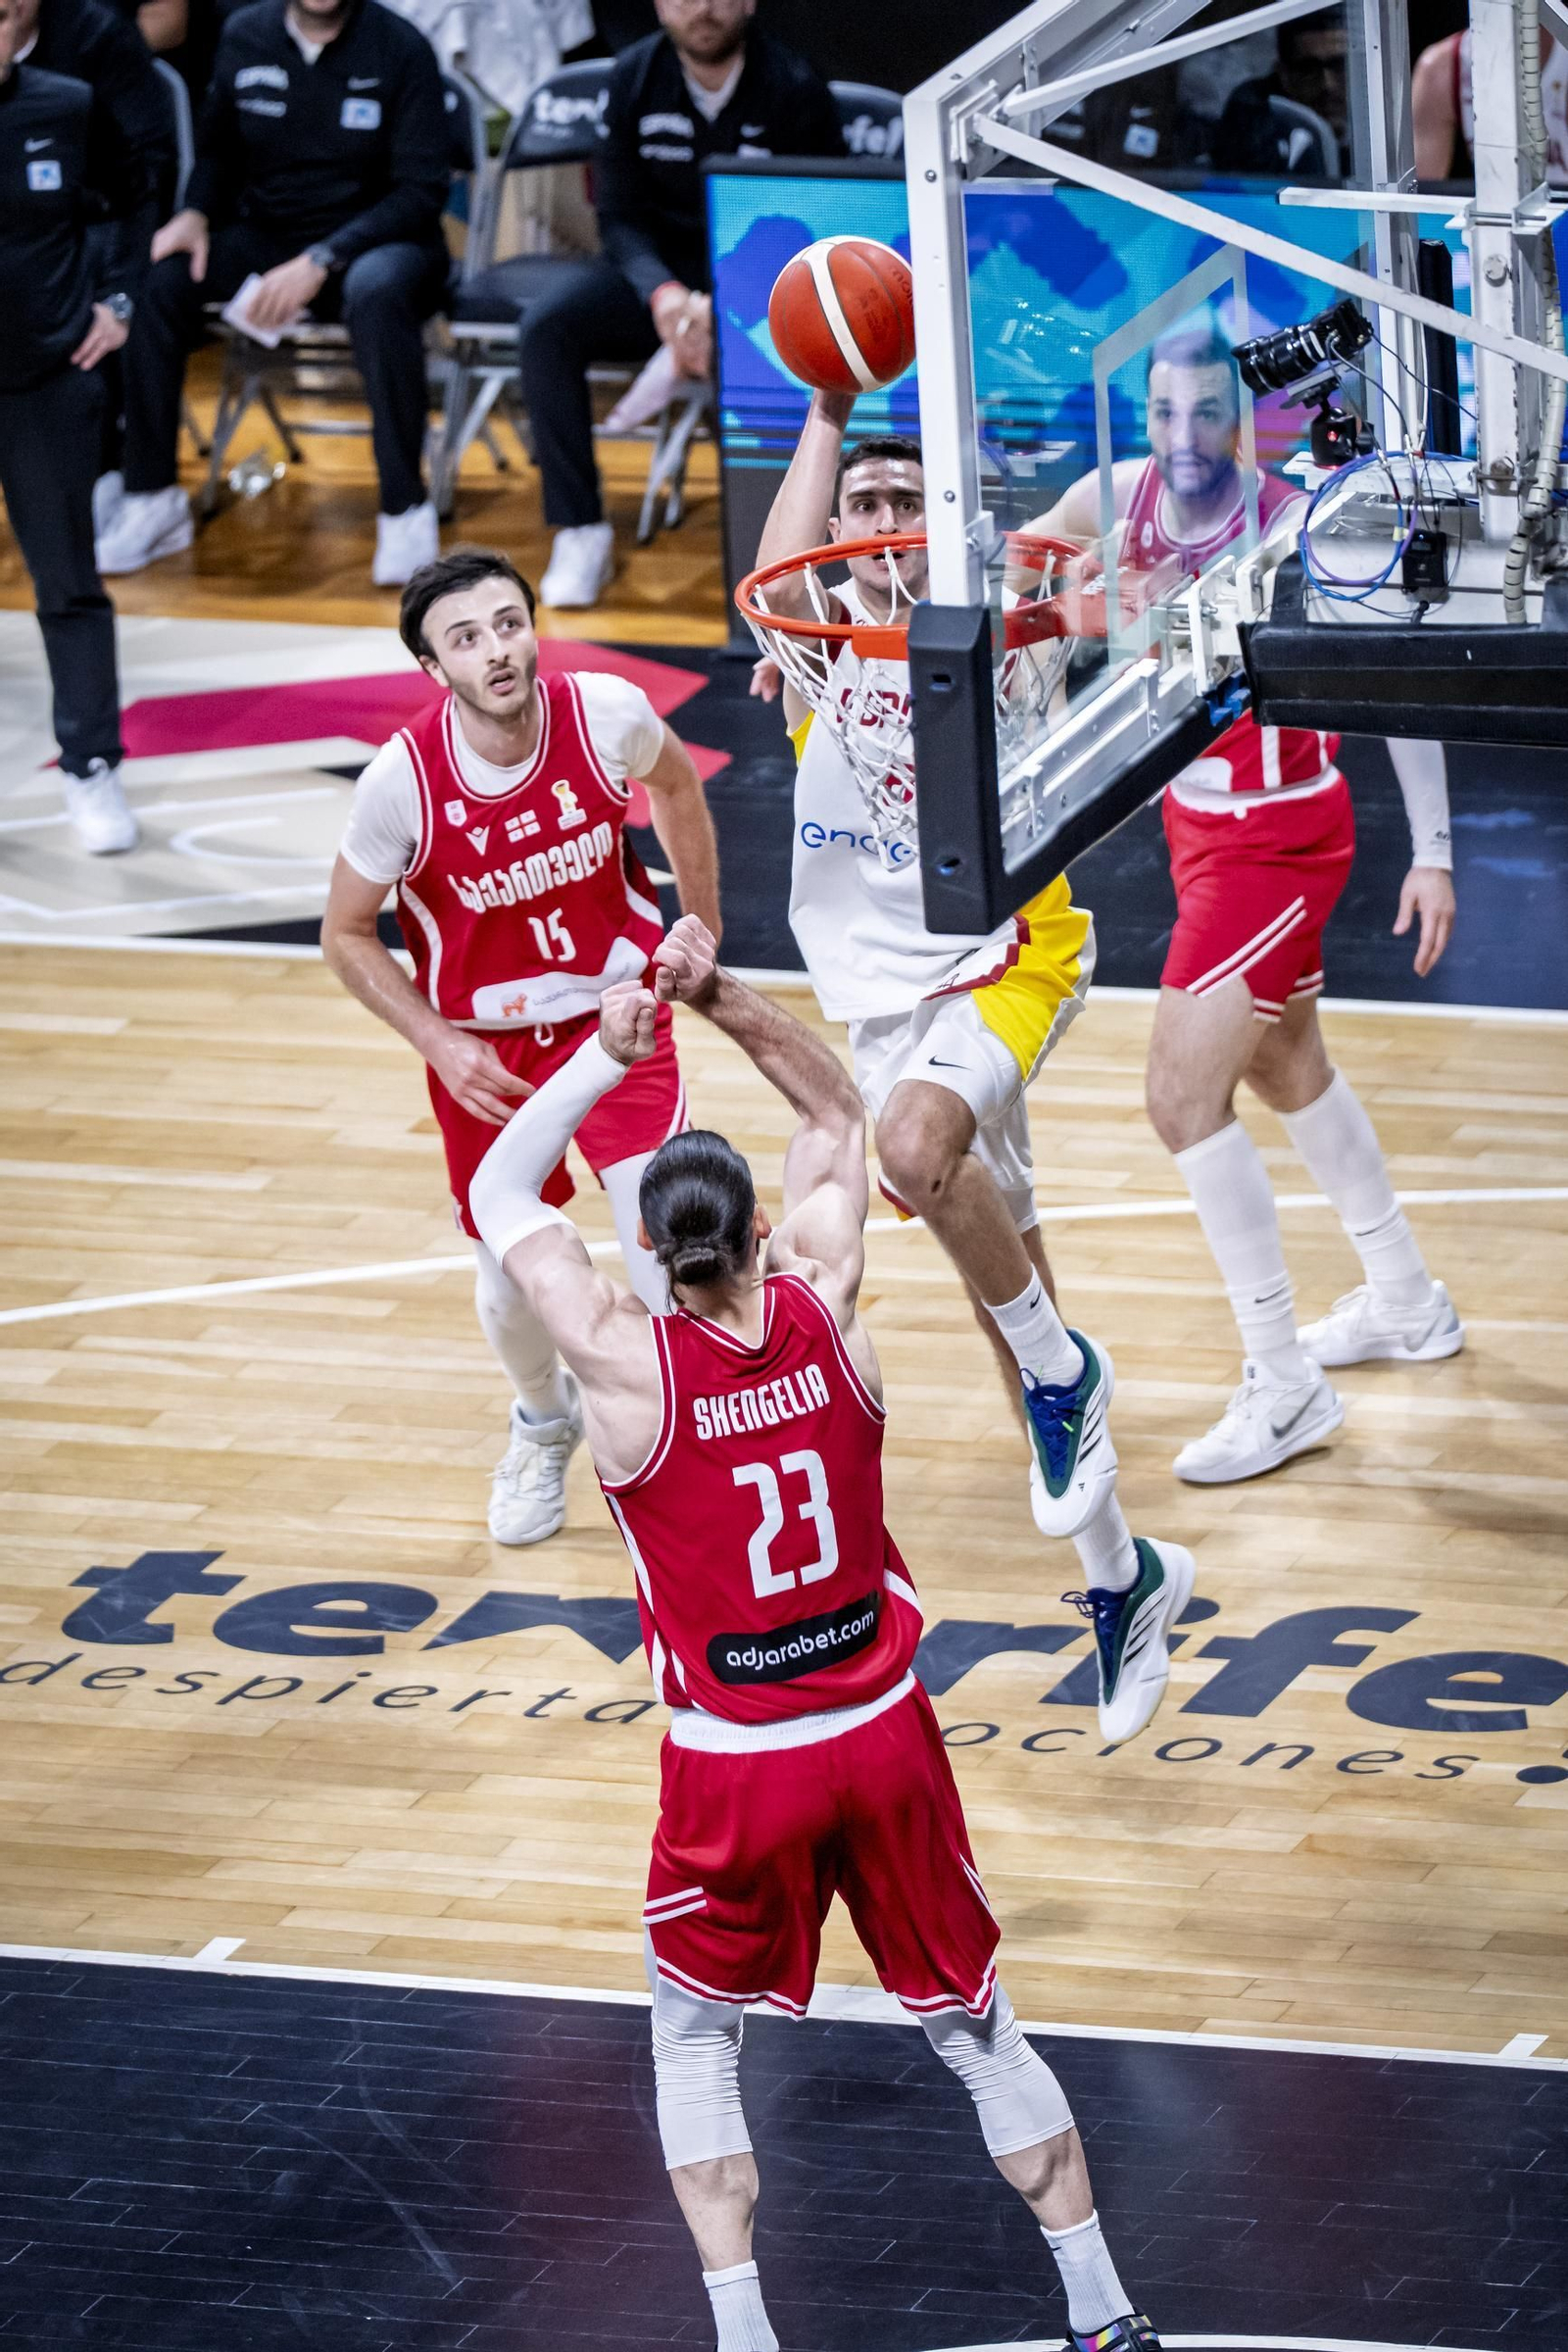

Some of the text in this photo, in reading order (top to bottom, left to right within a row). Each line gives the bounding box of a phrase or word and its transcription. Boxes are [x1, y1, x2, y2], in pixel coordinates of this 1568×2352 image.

[527, 907, 576, 961] 15
[693, 1364, 830, 1440] SHENGELIA
[732, 1449, 840, 1598] 23
[726, 1610, 874, 1671] adjarabet.com
[0, 1652, 658, 1724] despierta
